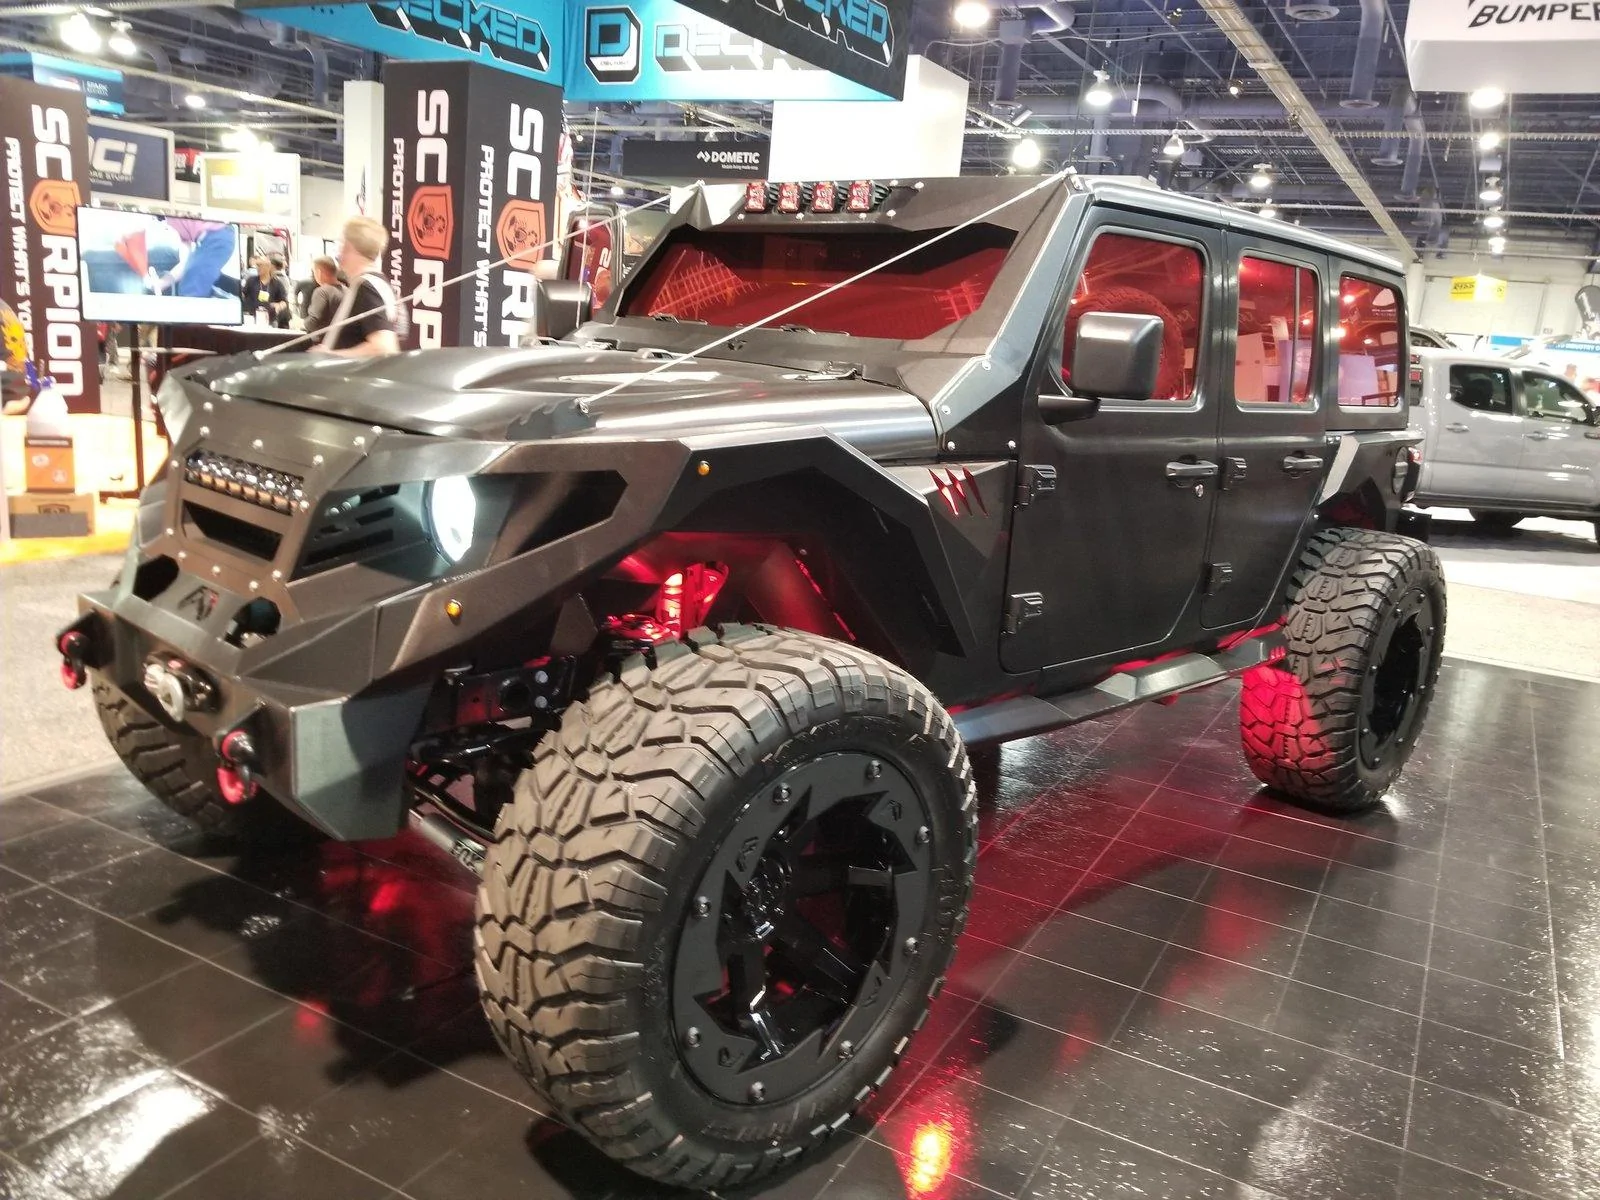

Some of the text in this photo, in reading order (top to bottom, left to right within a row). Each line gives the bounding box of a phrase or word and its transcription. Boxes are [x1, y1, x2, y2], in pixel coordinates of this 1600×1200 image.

[391, 138, 405, 243] PROTECT
[711, 151, 761, 164] DOMETIC
[473, 144, 495, 348] PROTECT WHAT'S
